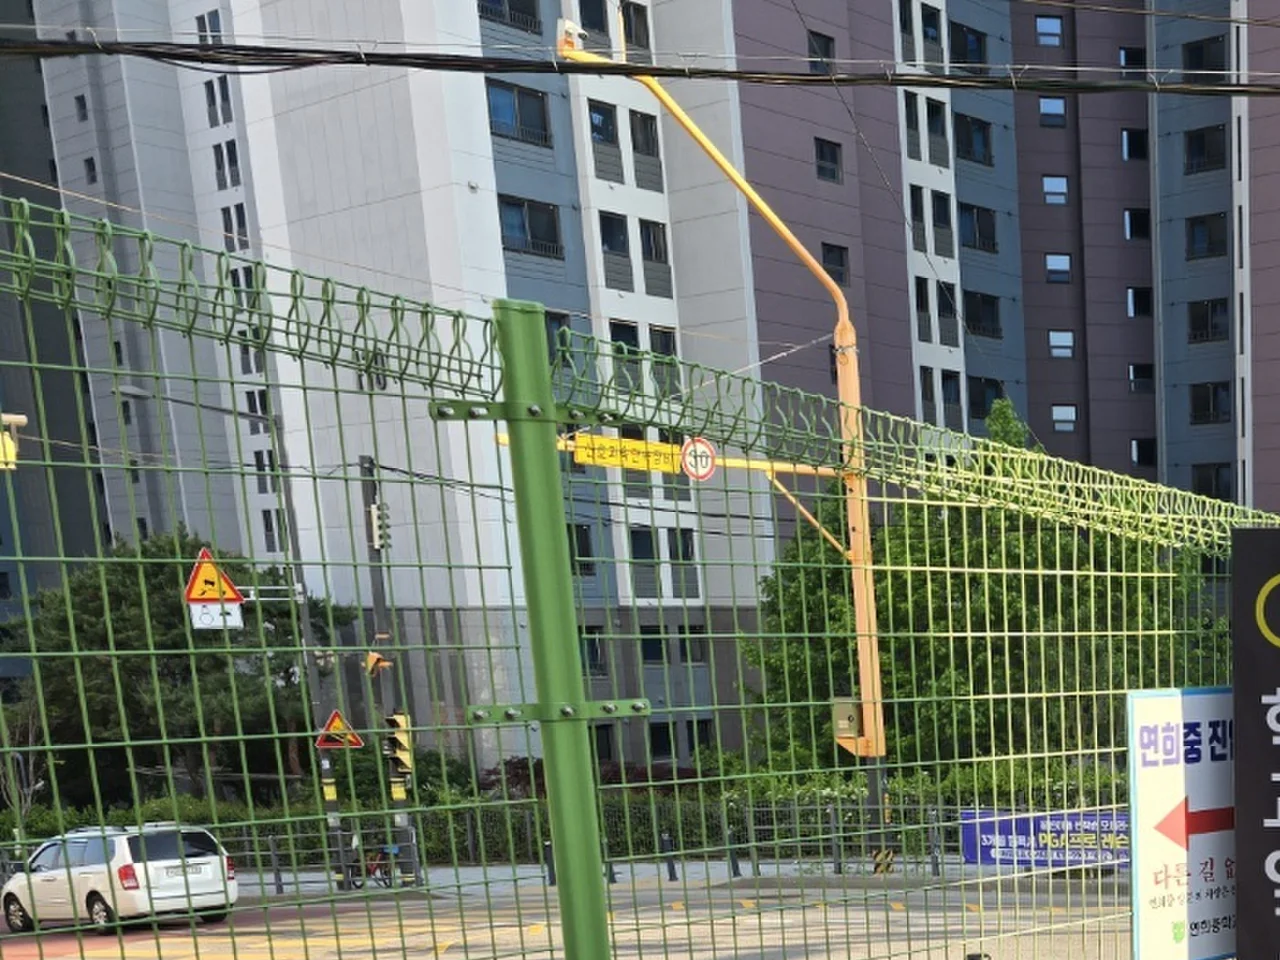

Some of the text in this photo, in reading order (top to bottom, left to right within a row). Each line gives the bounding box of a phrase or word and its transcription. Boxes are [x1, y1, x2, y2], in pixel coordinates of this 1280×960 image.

[689, 450, 709, 468] 30
[1140, 719, 1234, 767] 연희중 진
